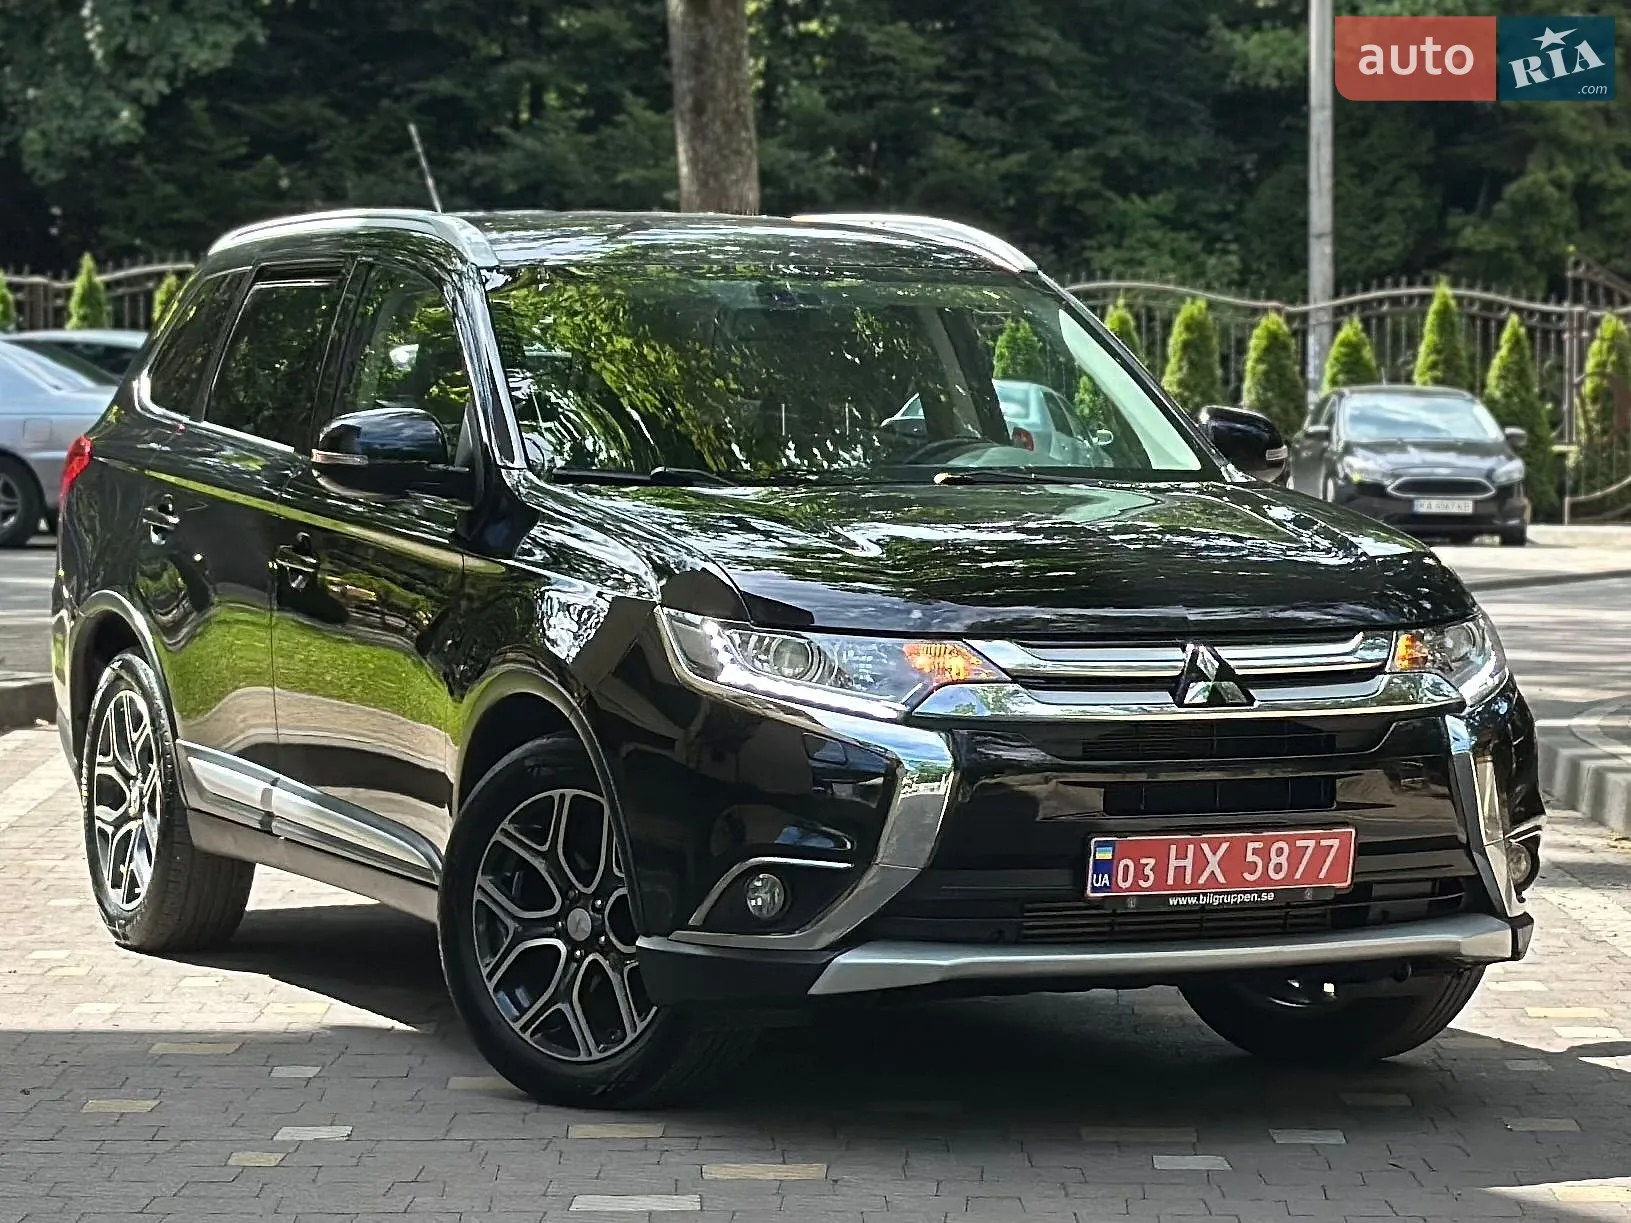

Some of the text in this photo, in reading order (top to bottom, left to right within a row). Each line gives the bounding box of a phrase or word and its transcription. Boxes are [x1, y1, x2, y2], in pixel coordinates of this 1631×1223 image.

[1116, 838, 1341, 889] 03 HX 5877
[1092, 873, 1110, 888] UA
[1168, 892, 1275, 906] www.bilgruppen.se
